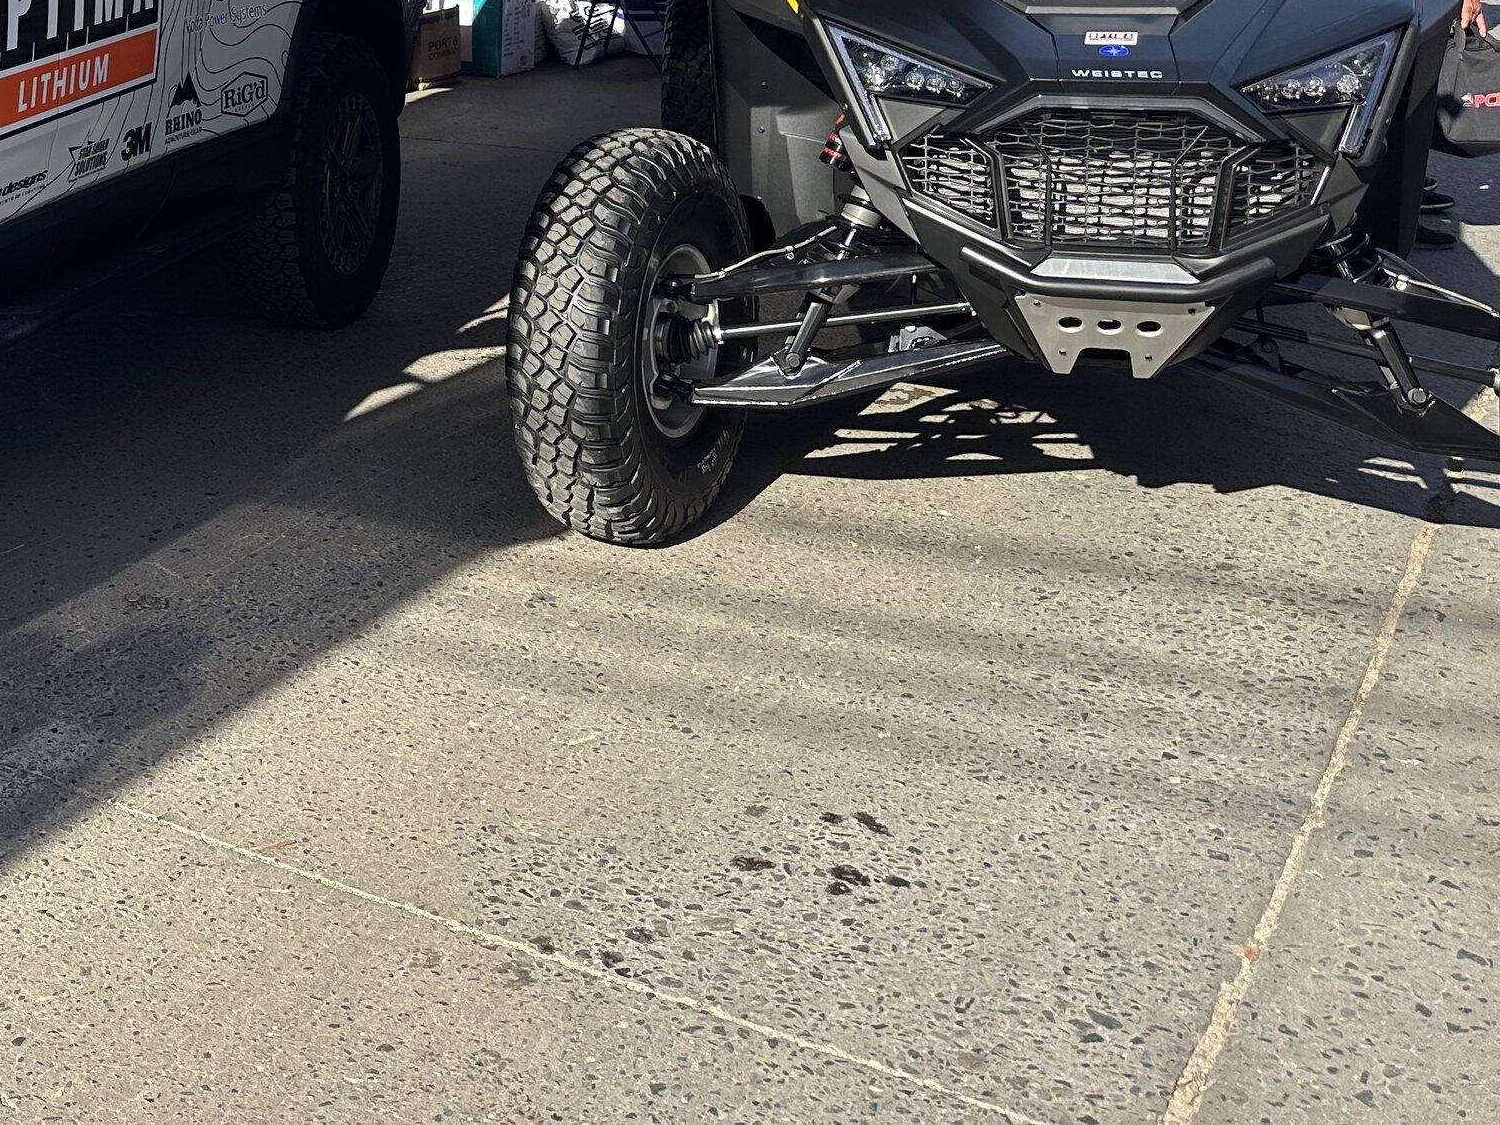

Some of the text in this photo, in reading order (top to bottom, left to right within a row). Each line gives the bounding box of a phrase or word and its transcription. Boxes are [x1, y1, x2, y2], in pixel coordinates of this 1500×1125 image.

[230, 4, 267, 26] Systems
[428, 36, 452, 53] PORT
[17, 53, 111, 114] LITHIUM
[1071, 69, 1163, 79] WEISTEC
[164, 108, 203, 136] RHINO
[120, 122, 153, 162] 3M
[1, 170, 48, 199] designs
